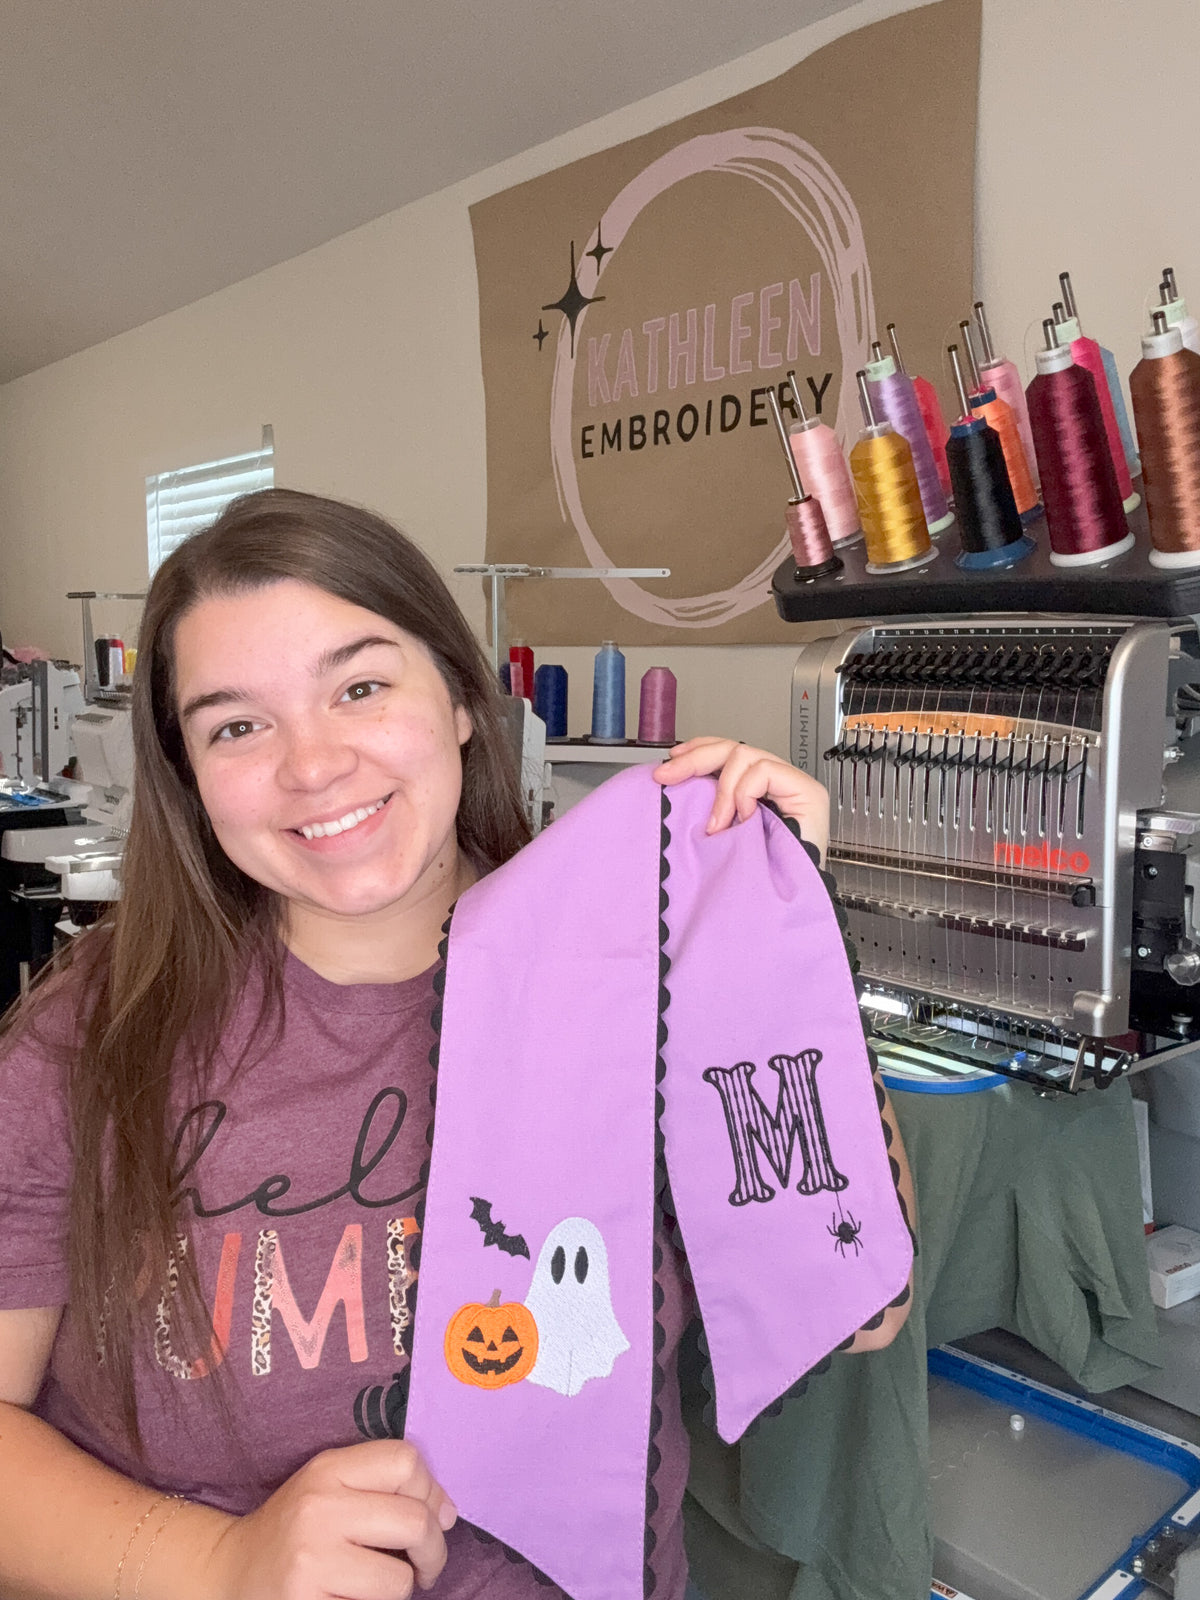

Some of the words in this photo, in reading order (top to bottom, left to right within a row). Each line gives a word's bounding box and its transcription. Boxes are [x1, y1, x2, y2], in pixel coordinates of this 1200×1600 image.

[587, 271, 821, 407] KATHLEEN
[581, 372, 833, 459] EMBROIDERY
[798, 704, 809, 770] SUMMIT
[994, 840, 1091, 874] melco
[168, 1086, 426, 1218] hel
[702, 1048, 849, 1207] M
